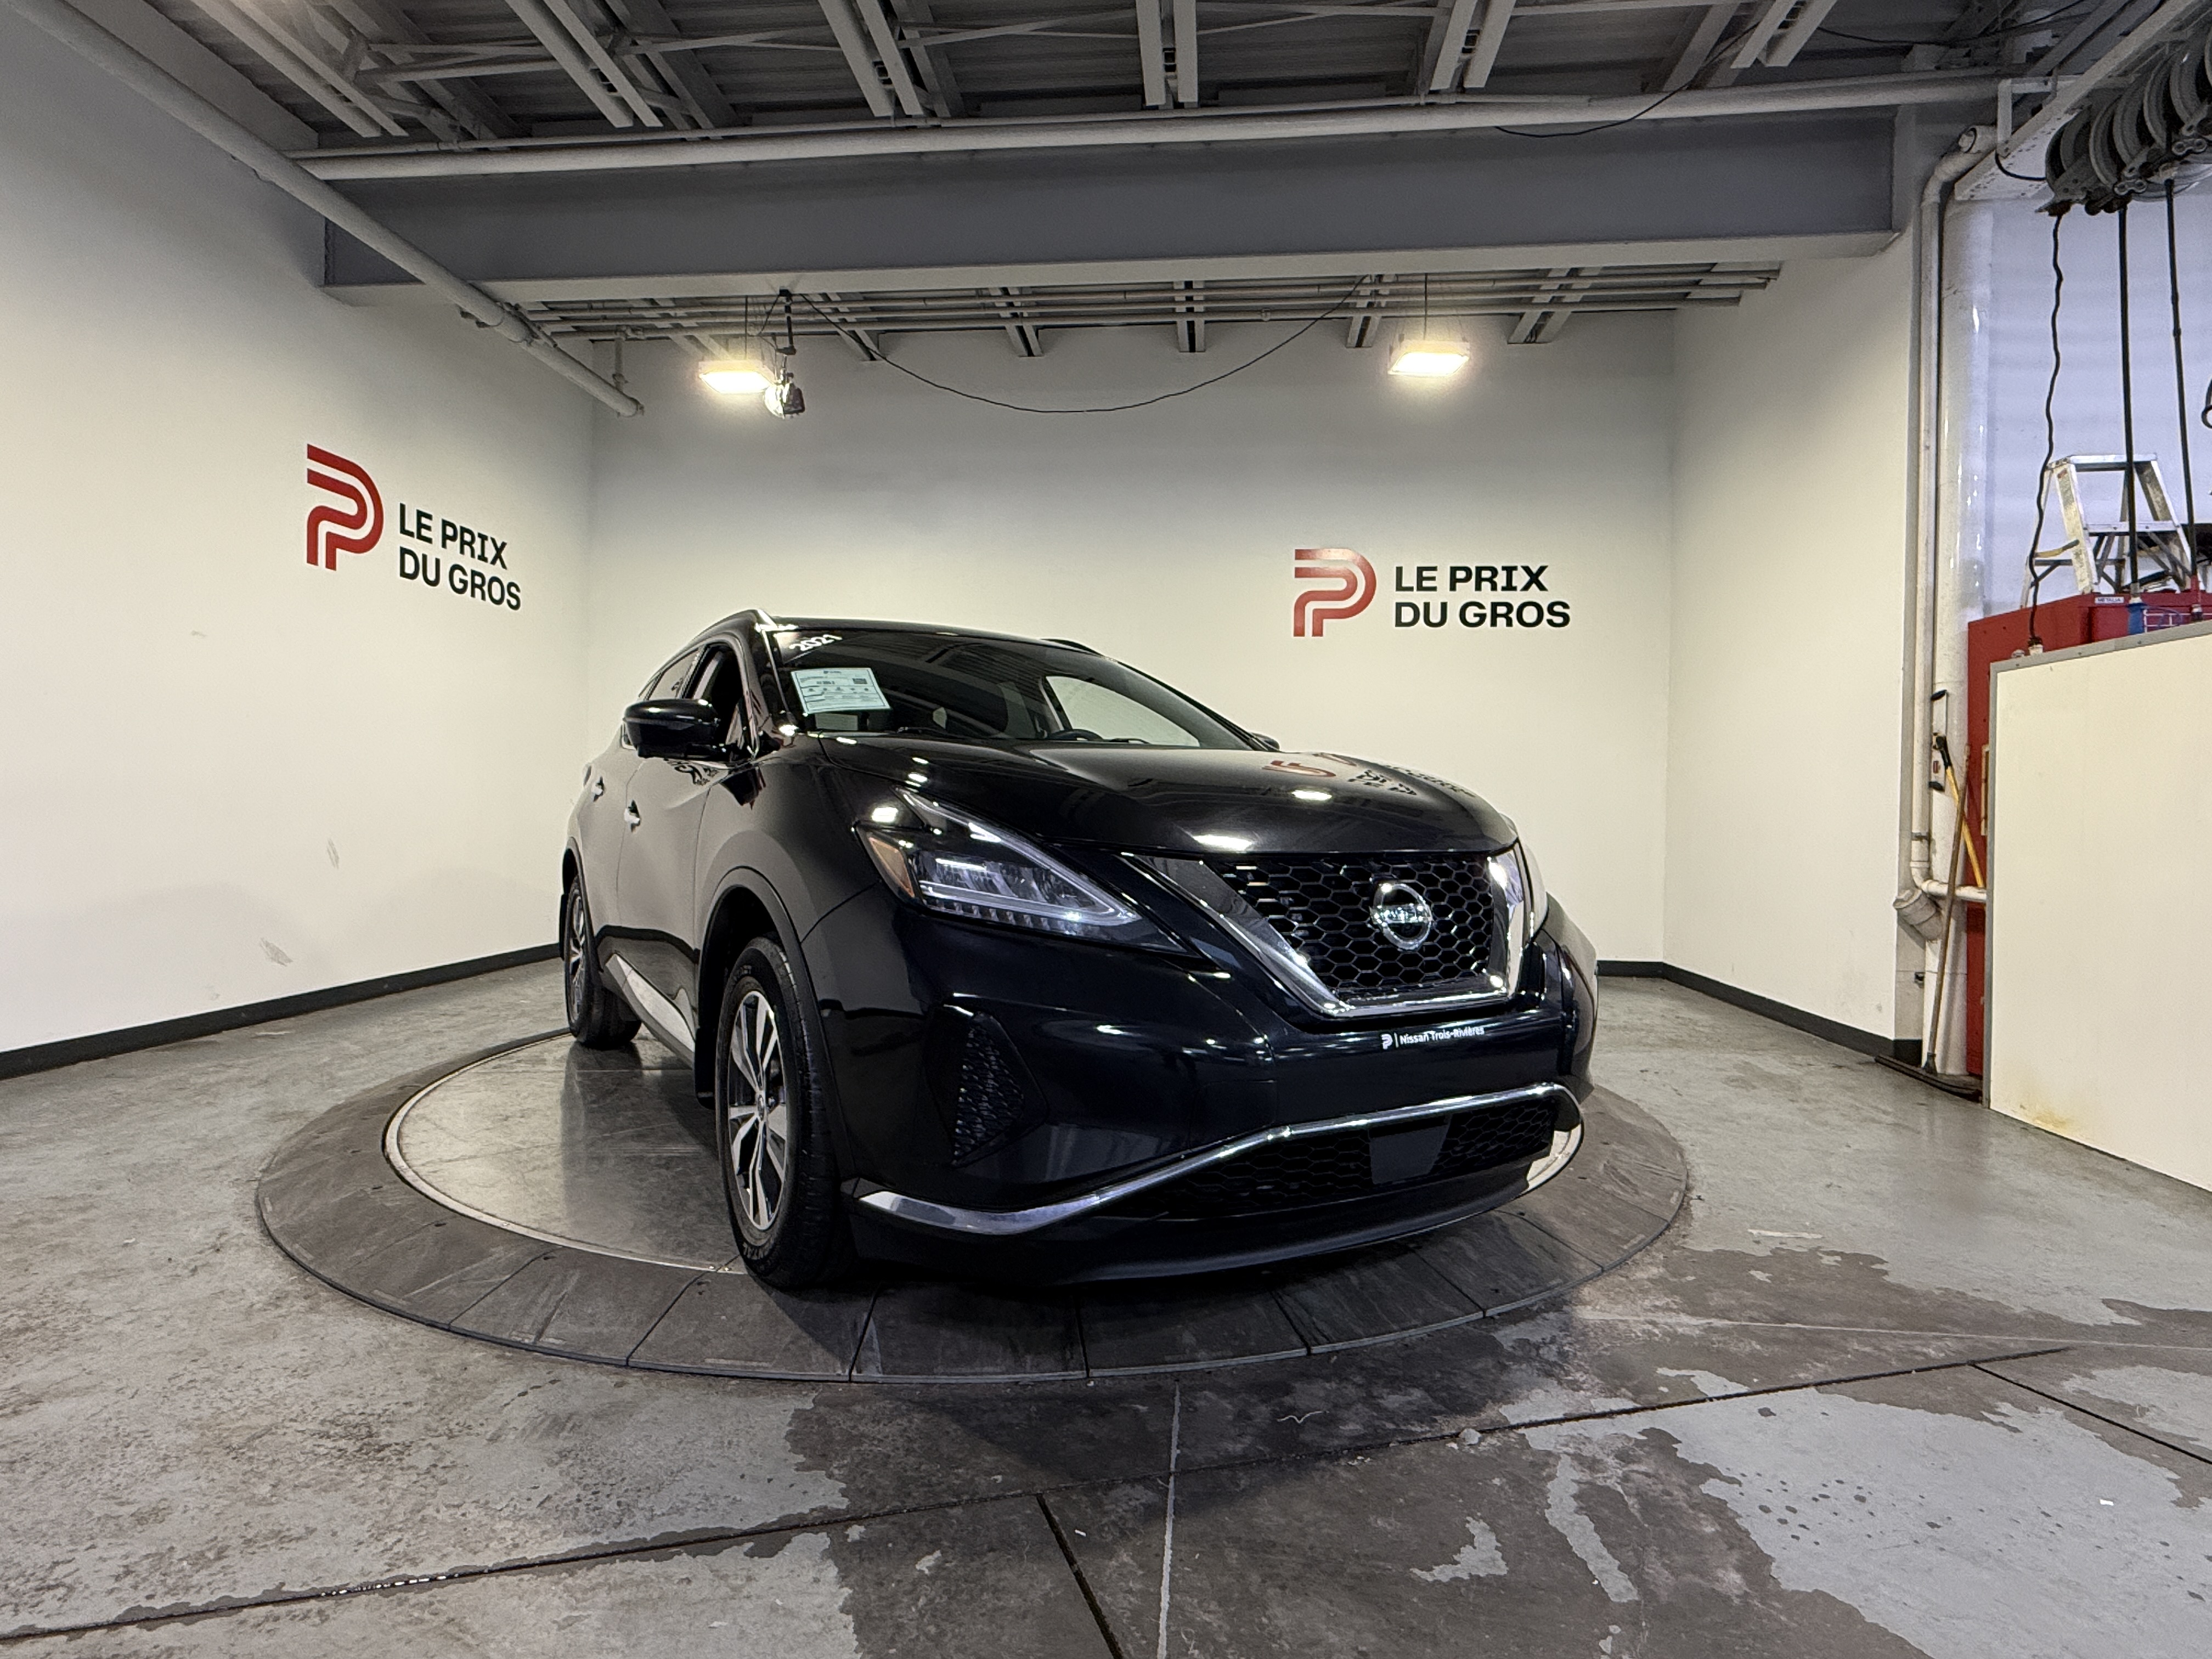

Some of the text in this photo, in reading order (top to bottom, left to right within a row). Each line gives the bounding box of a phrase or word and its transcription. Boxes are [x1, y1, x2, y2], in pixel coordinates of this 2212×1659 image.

[400, 503, 507, 569] LE PRIX
[400, 546, 521, 611] DU GROS
[1395, 566, 1548, 591] LE PRIX
[1395, 601, 1570, 628] DU GROS
[789, 634, 842, 651] 2021
[1400, 1032, 1429, 1045] Nissan
